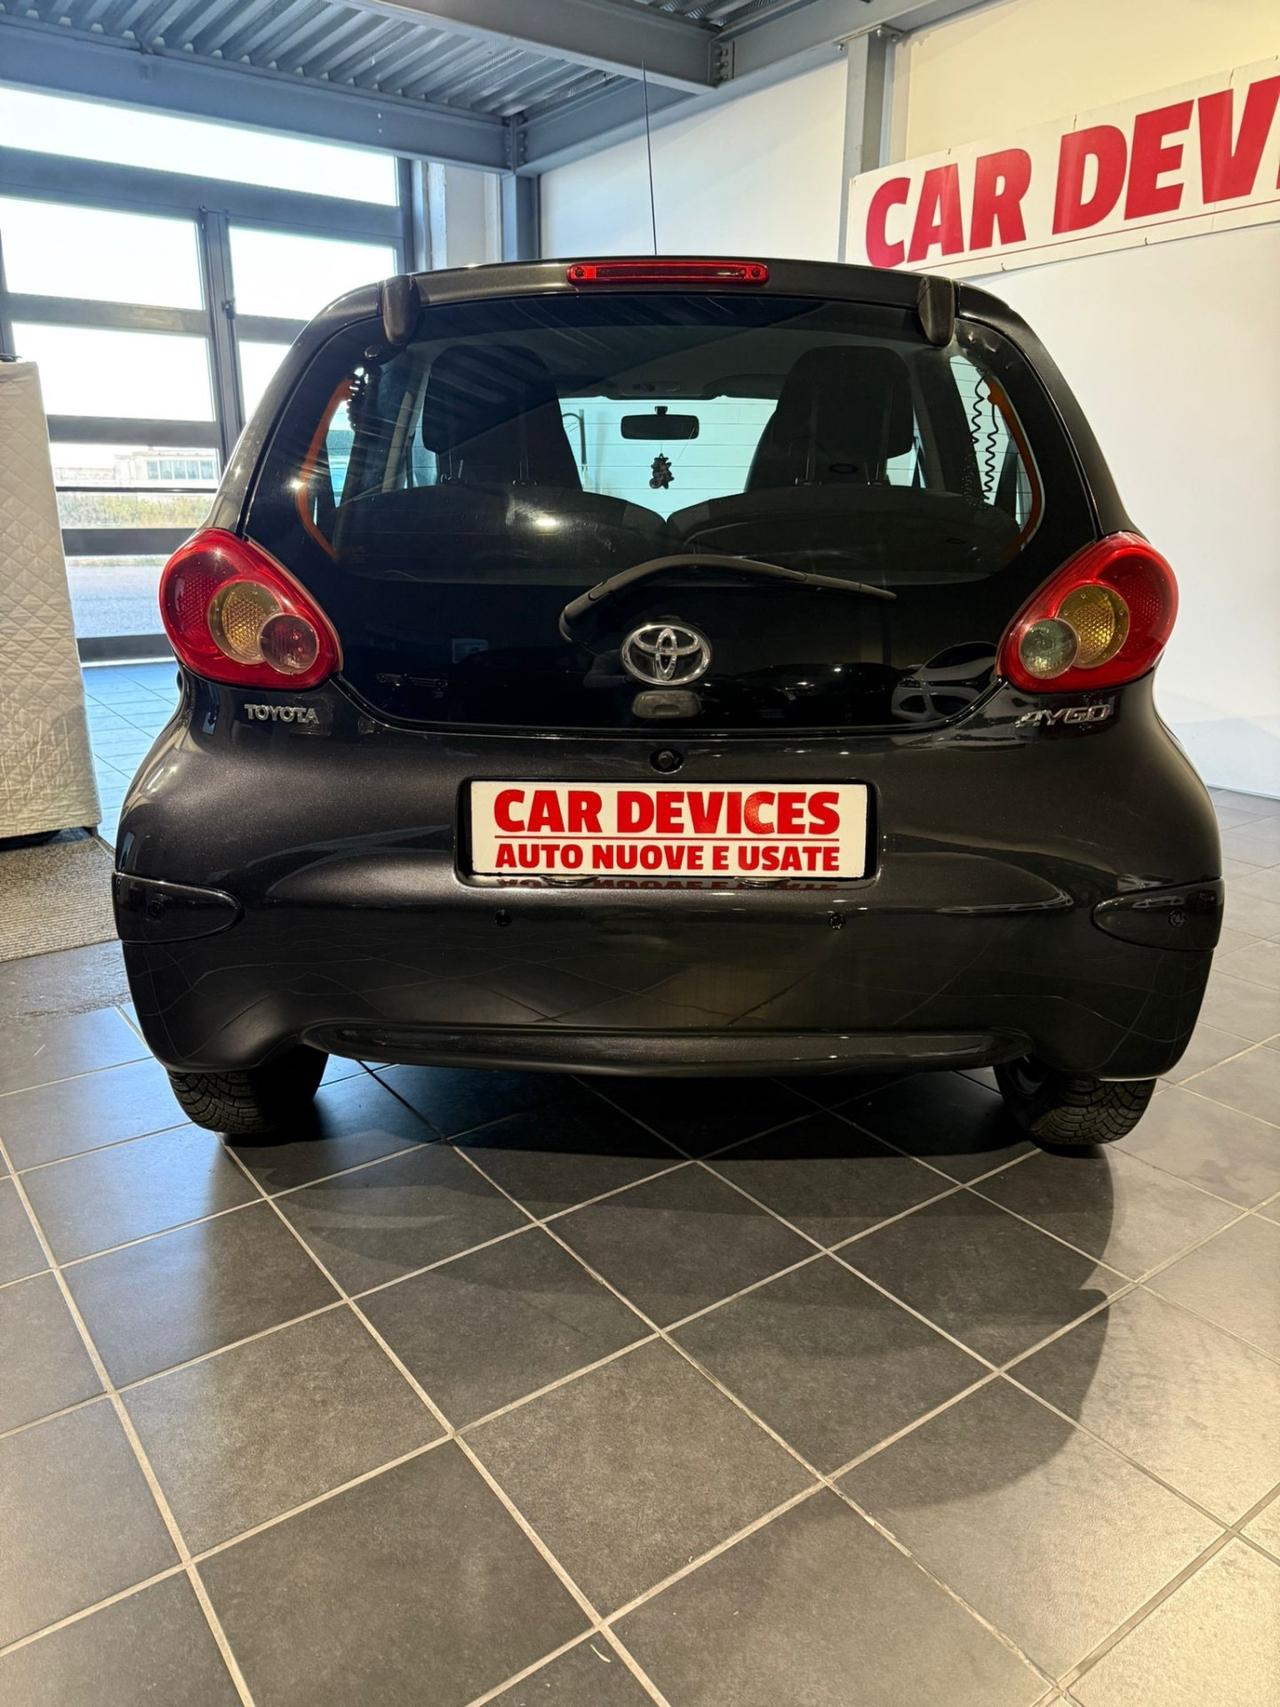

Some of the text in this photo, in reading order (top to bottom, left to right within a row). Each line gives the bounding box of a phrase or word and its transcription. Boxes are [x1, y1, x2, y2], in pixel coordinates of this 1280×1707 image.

[866, 74, 1280, 268] CAR DEV
[244, 703, 320, 725] TOYOTA
[1014, 704, 1112, 728] AYGO
[493, 789, 841, 835] CAR DEVICES
[495, 843, 840, 871] AUTO NUOVE E USATE
